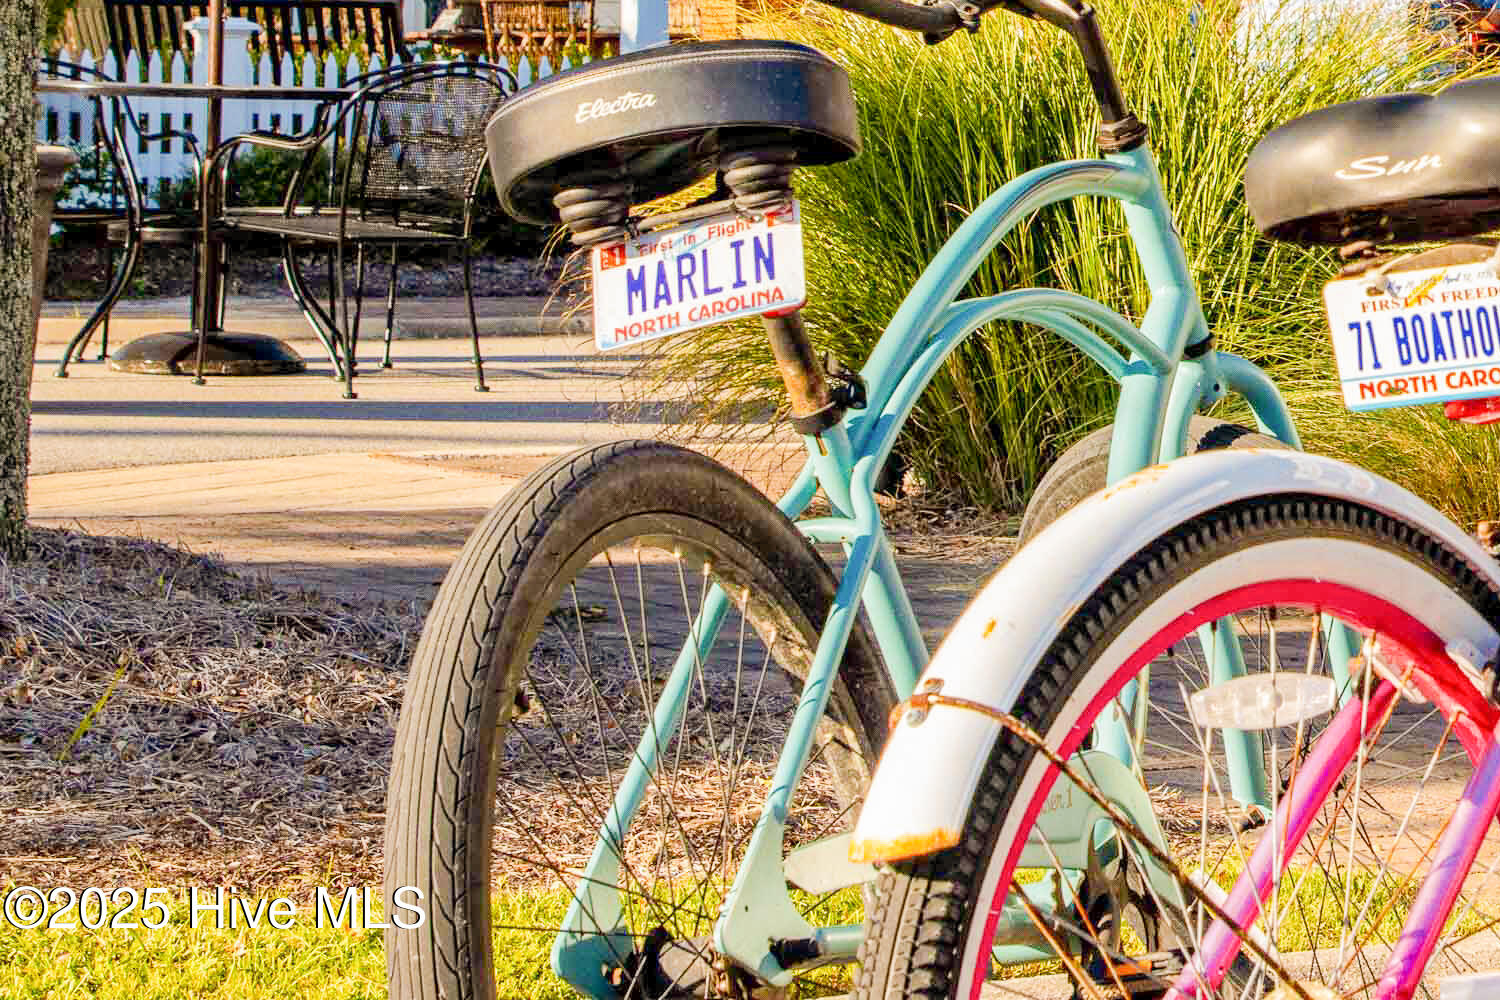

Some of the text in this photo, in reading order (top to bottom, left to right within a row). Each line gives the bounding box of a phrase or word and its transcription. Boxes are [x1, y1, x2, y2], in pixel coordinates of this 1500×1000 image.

[575, 92, 657, 125] Electra
[1335, 154, 1443, 181] Sun
[707, 216, 755, 241] Flight
[626, 233, 776, 315] MARLIN
[614, 286, 785, 343] NORTH CAROLINA
[1360, 296, 1411, 314] FIRST
[1416, 294, 1435, 307] IN
[1348, 320, 1382, 371] 71
[1359, 375, 1438, 400] NORTH
